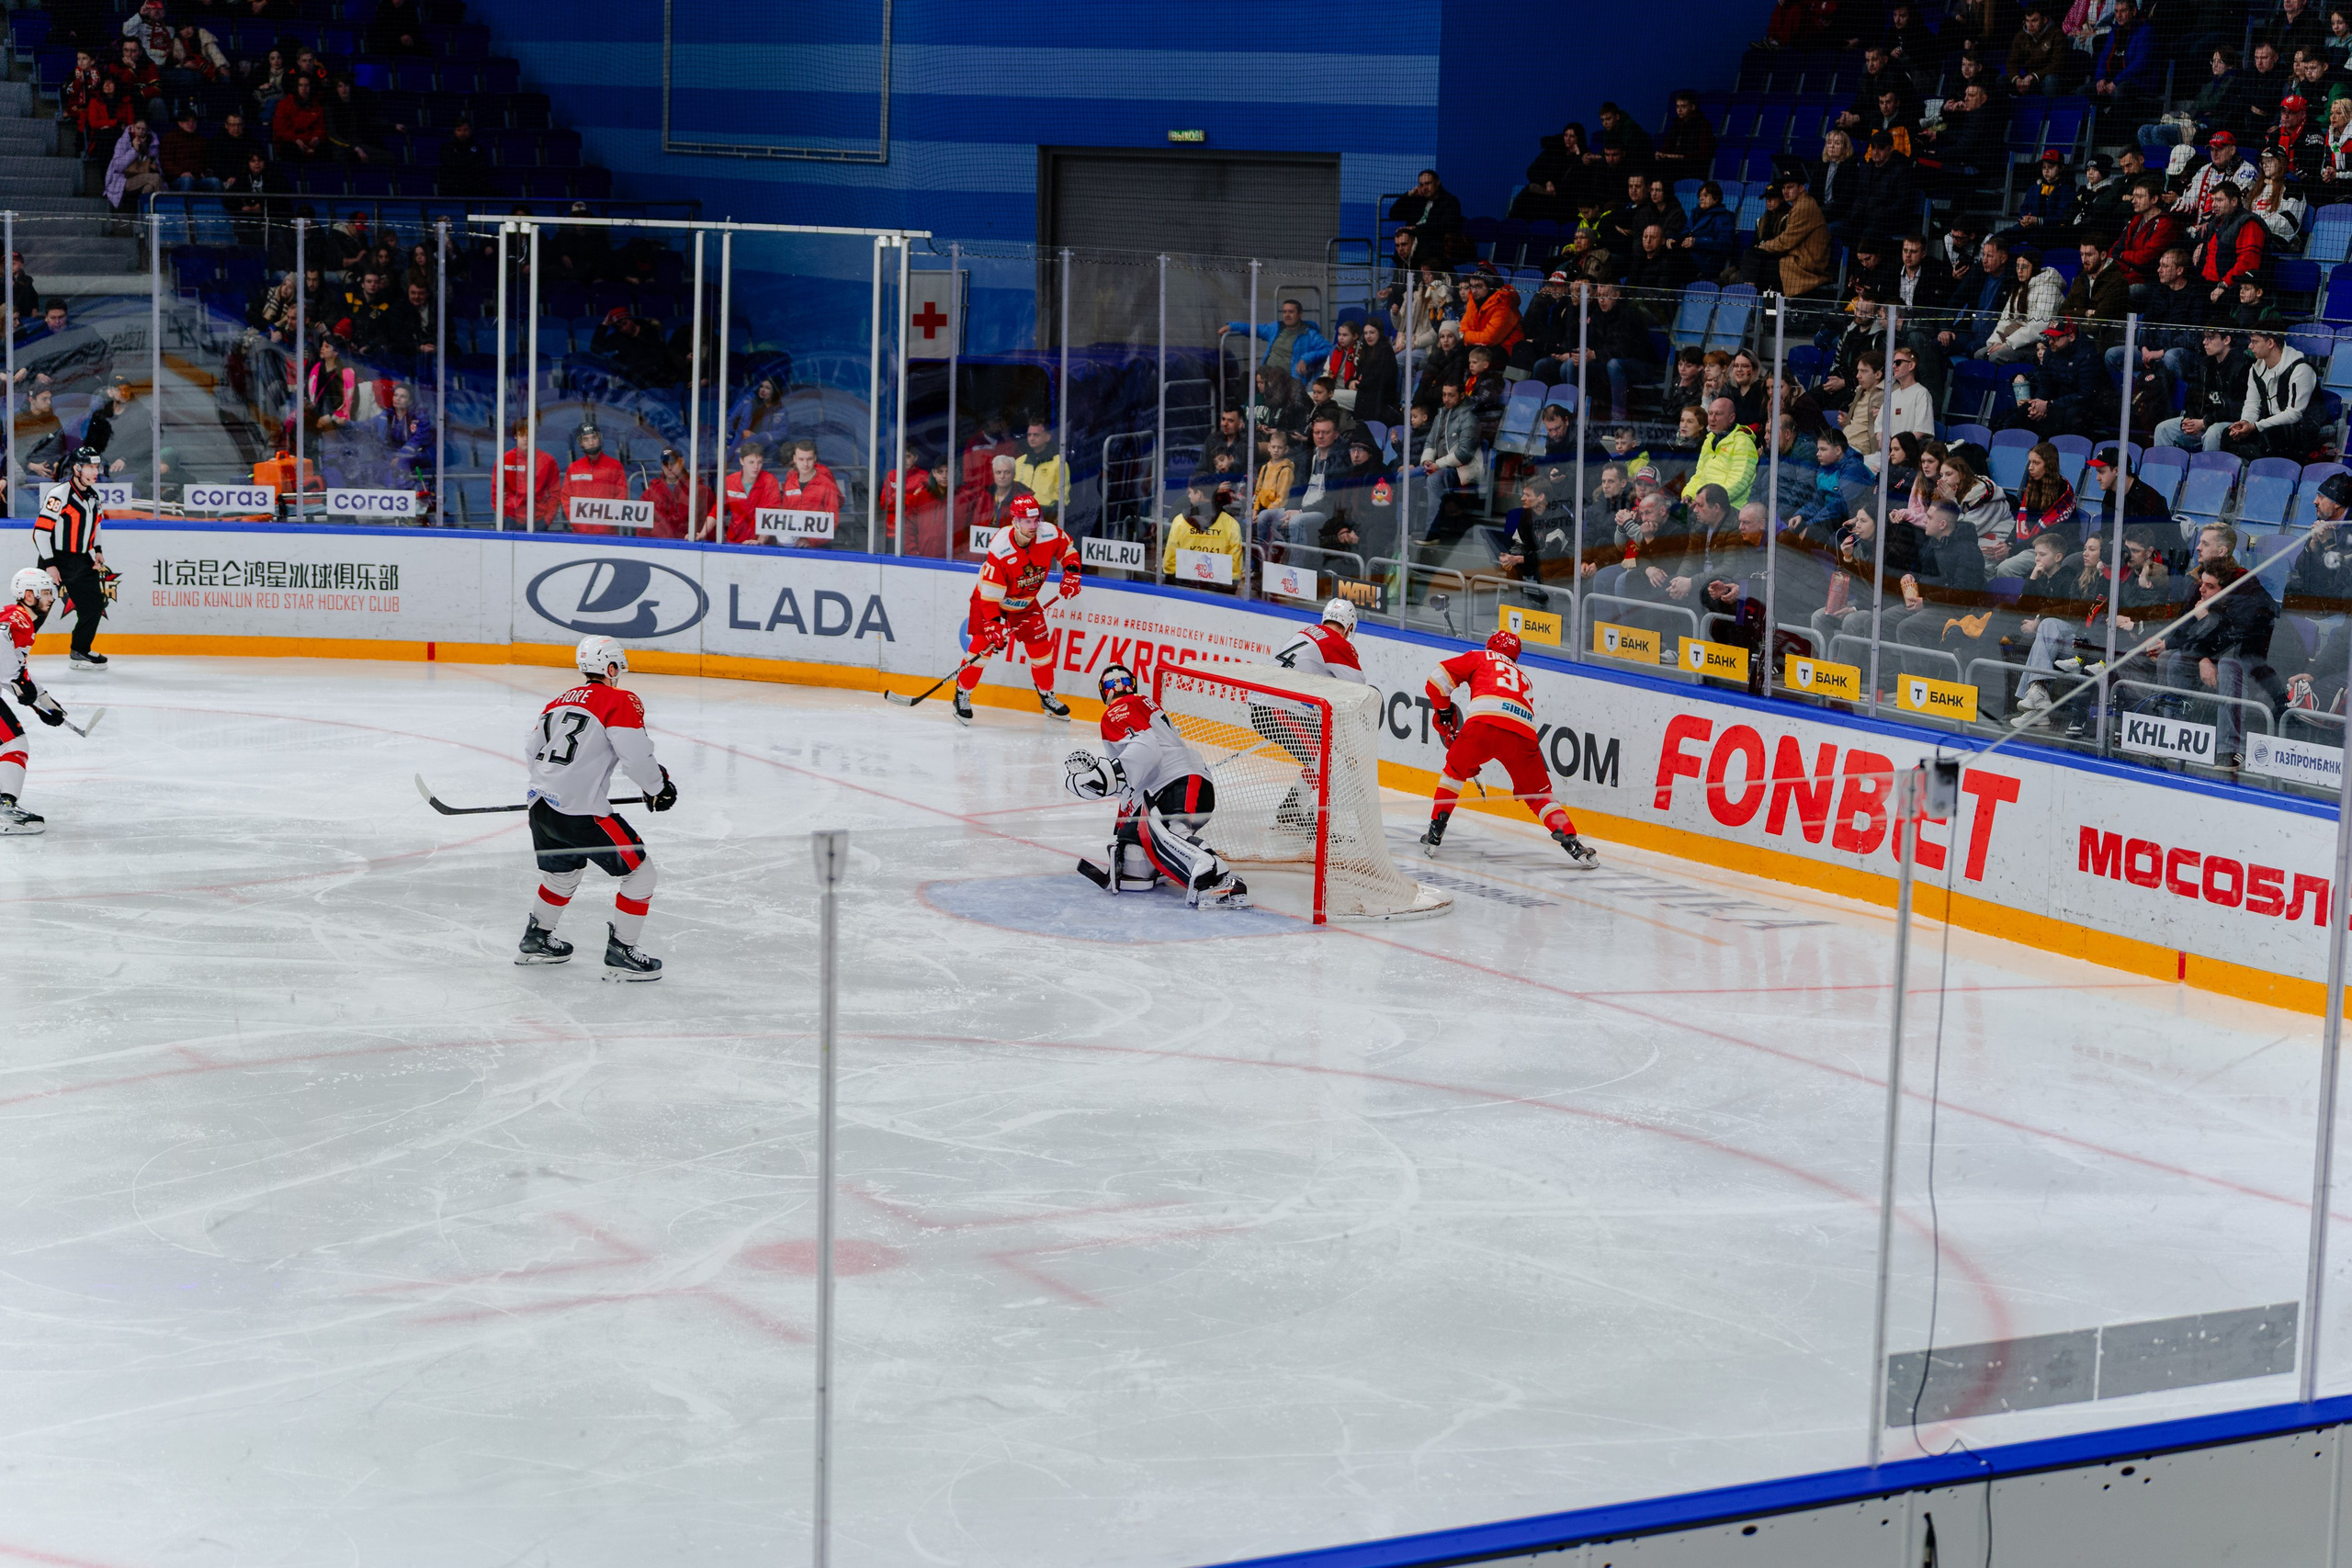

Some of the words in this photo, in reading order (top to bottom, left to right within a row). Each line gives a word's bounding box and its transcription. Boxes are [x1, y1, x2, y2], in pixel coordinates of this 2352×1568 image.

[47, 496, 62, 513] 38
[575, 502, 649, 523] KHL.RU
[761, 513, 830, 533] KHL.RU
[1085, 542, 1141, 565] KHL.RU
[153, 558, 399, 591] 北京昆仑鸿星冰球俱乐部
[153, 590, 199, 607] BEIJING
[204, 591, 252, 608] KUNLUN
[256, 592, 279, 609] RED
[284, 593, 314, 610] STAR
[318, 594, 365, 611] HOCKEY
[369, 595, 400, 612] CLUB
[1004, 598, 1028, 607] SIBU
[1338, 579, 1382, 610] МАТЧ!
[729, 583, 896, 642] LADA
[1070, 610, 1082, 621] НА
[1088, 612, 1119, 626] СВЯЗИ
[1124, 617, 1204, 642] #REDSTARHOCKEY
[1207, 634, 1272, 655] #UNITEDWEWIN
[1524, 620, 1551, 635] БАНК
[1621, 637, 1649, 652] БАНК
[1707, 653, 1736, 669] БАНК
[1816, 671, 1847, 688] БАНК
[1930, 691, 1963, 707] БАНК
[1501, 702, 1532, 722] SIBUR
[535, 711, 591, 766] 13
[2127, 719, 2210, 755] KHL.RU
[2274, 750, 2341, 775] ГАЗПРОМБАНК
[2078, 825, 2352, 931] МОСОБЛ
